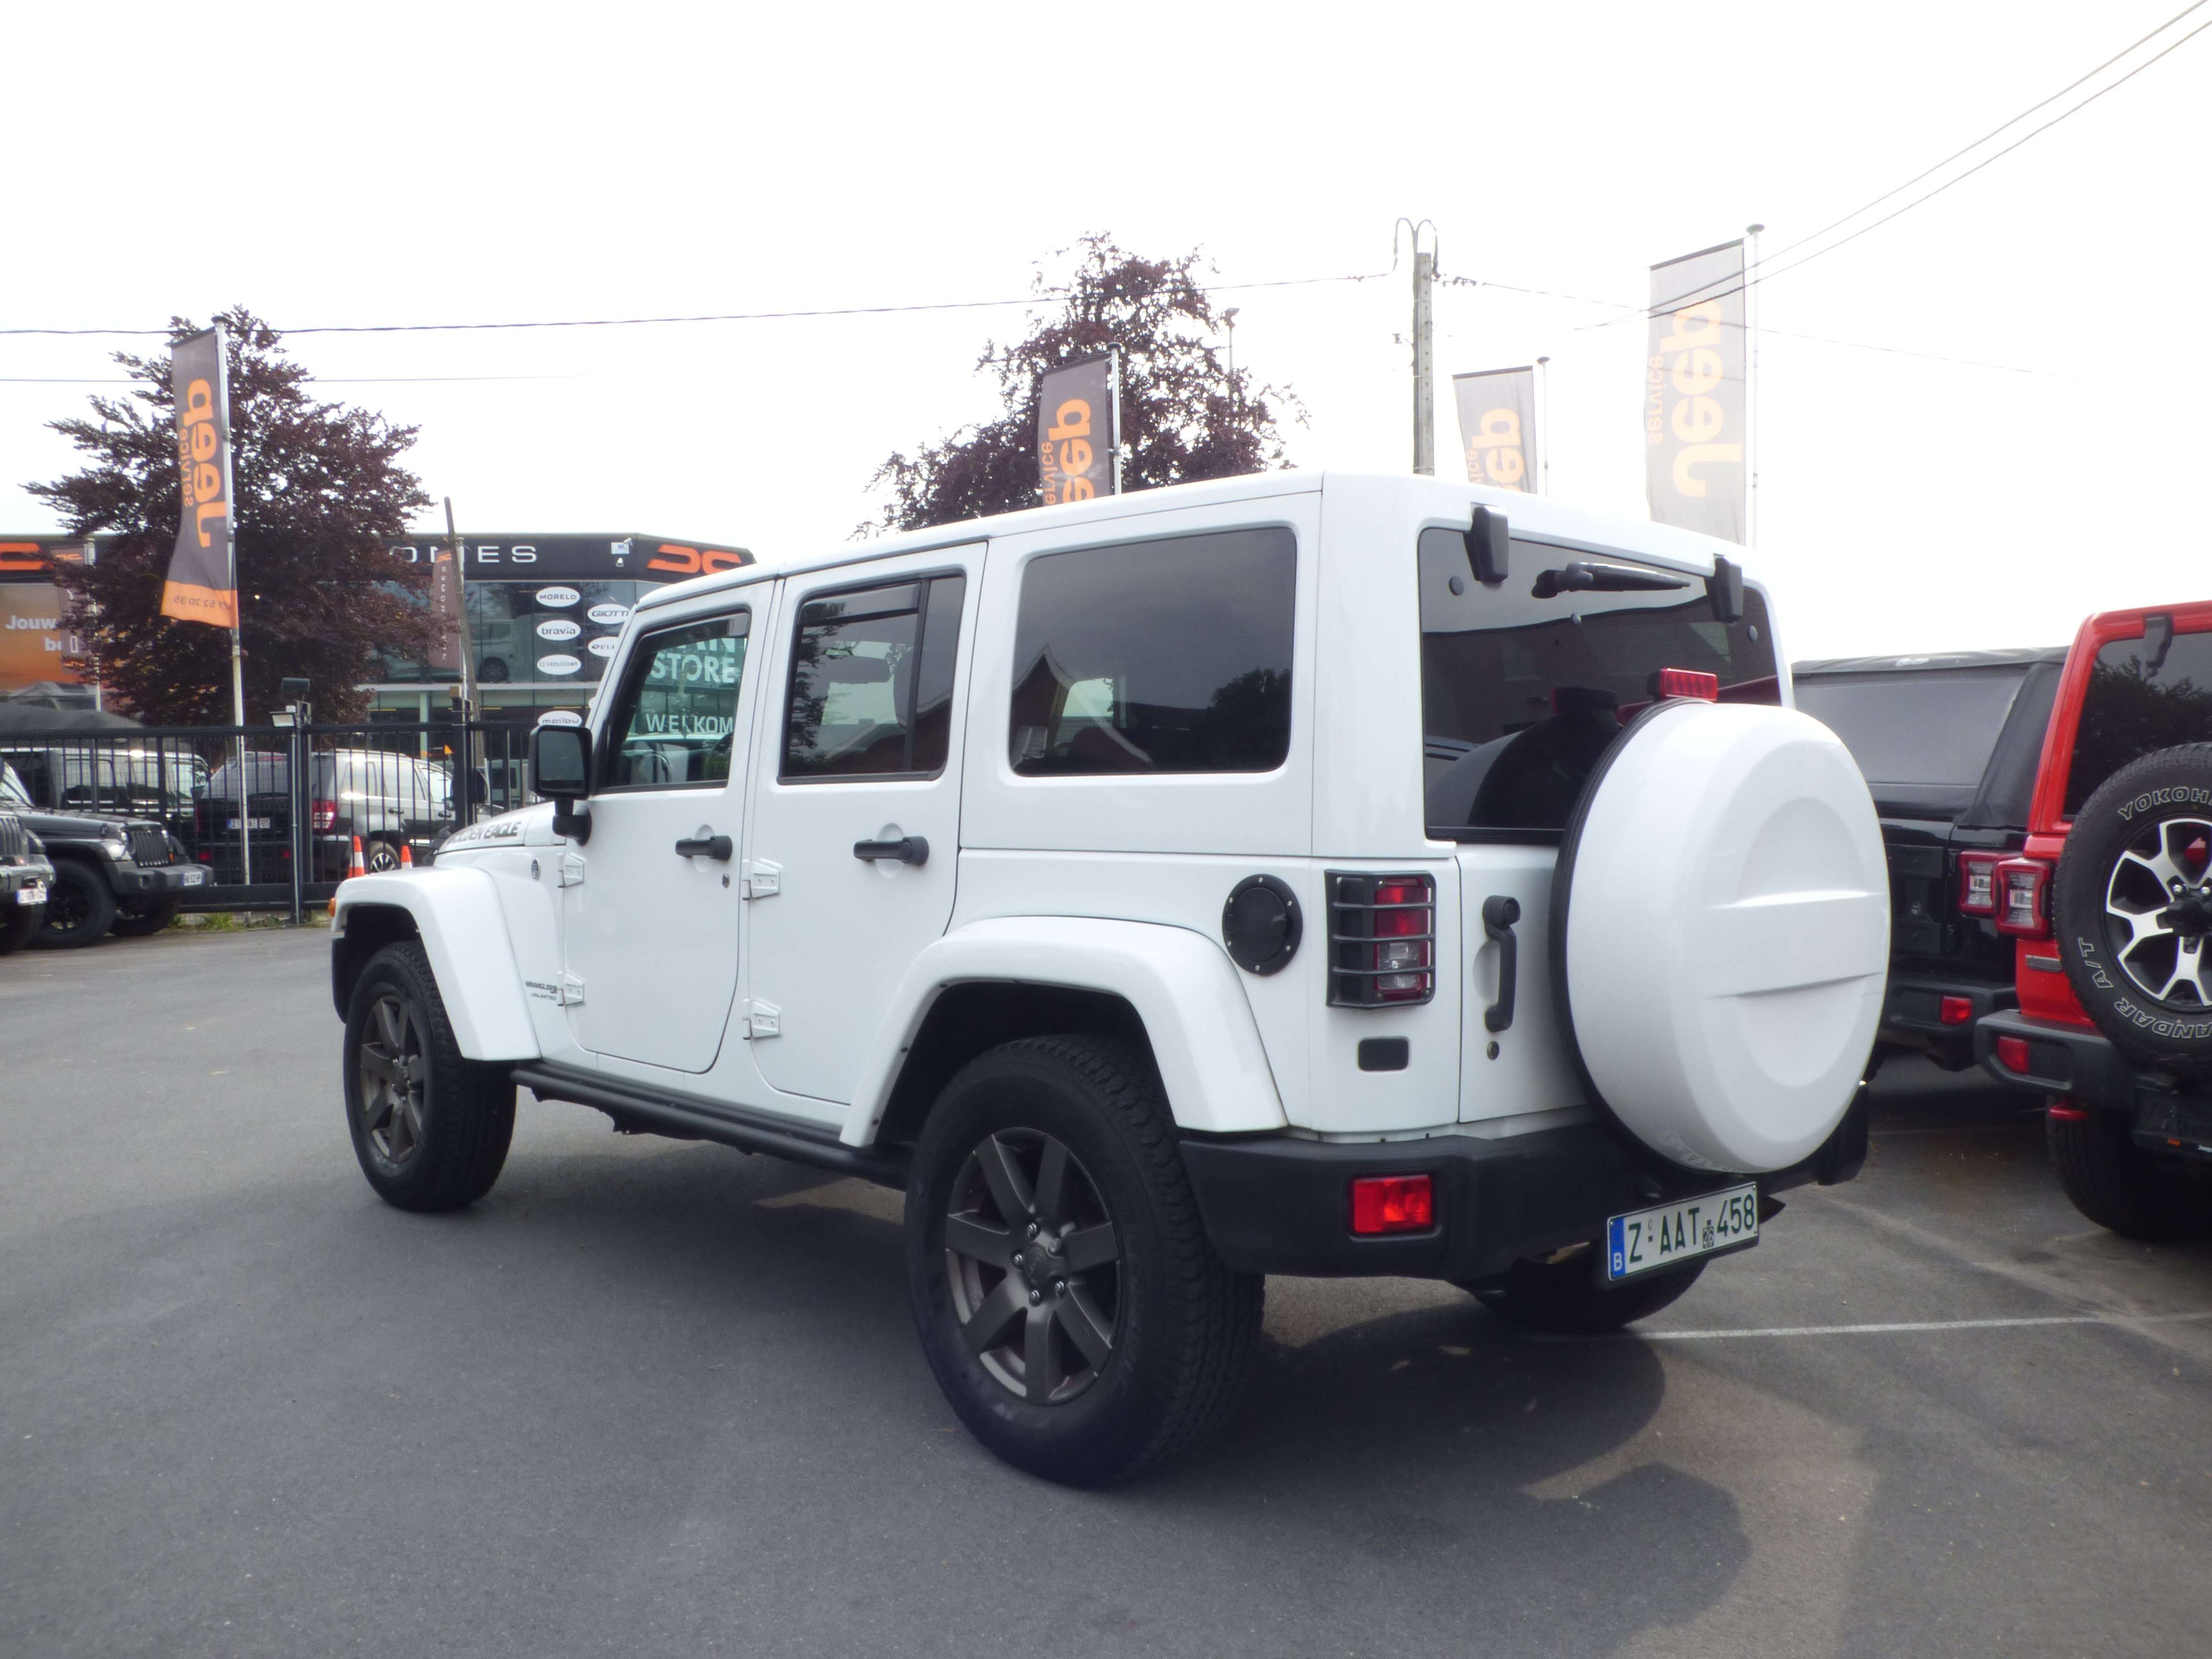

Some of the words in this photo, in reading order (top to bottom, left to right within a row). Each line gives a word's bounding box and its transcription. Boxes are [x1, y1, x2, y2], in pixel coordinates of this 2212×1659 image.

[5, 615, 57, 630] Jouw
[541, 627, 576, 635] bravia
[650, 651, 735, 683] STORE
[645, 713, 733, 734] WELKOM
[2117, 786, 2212, 820] YOKOH
[1613, 1252, 1623, 1271] B
